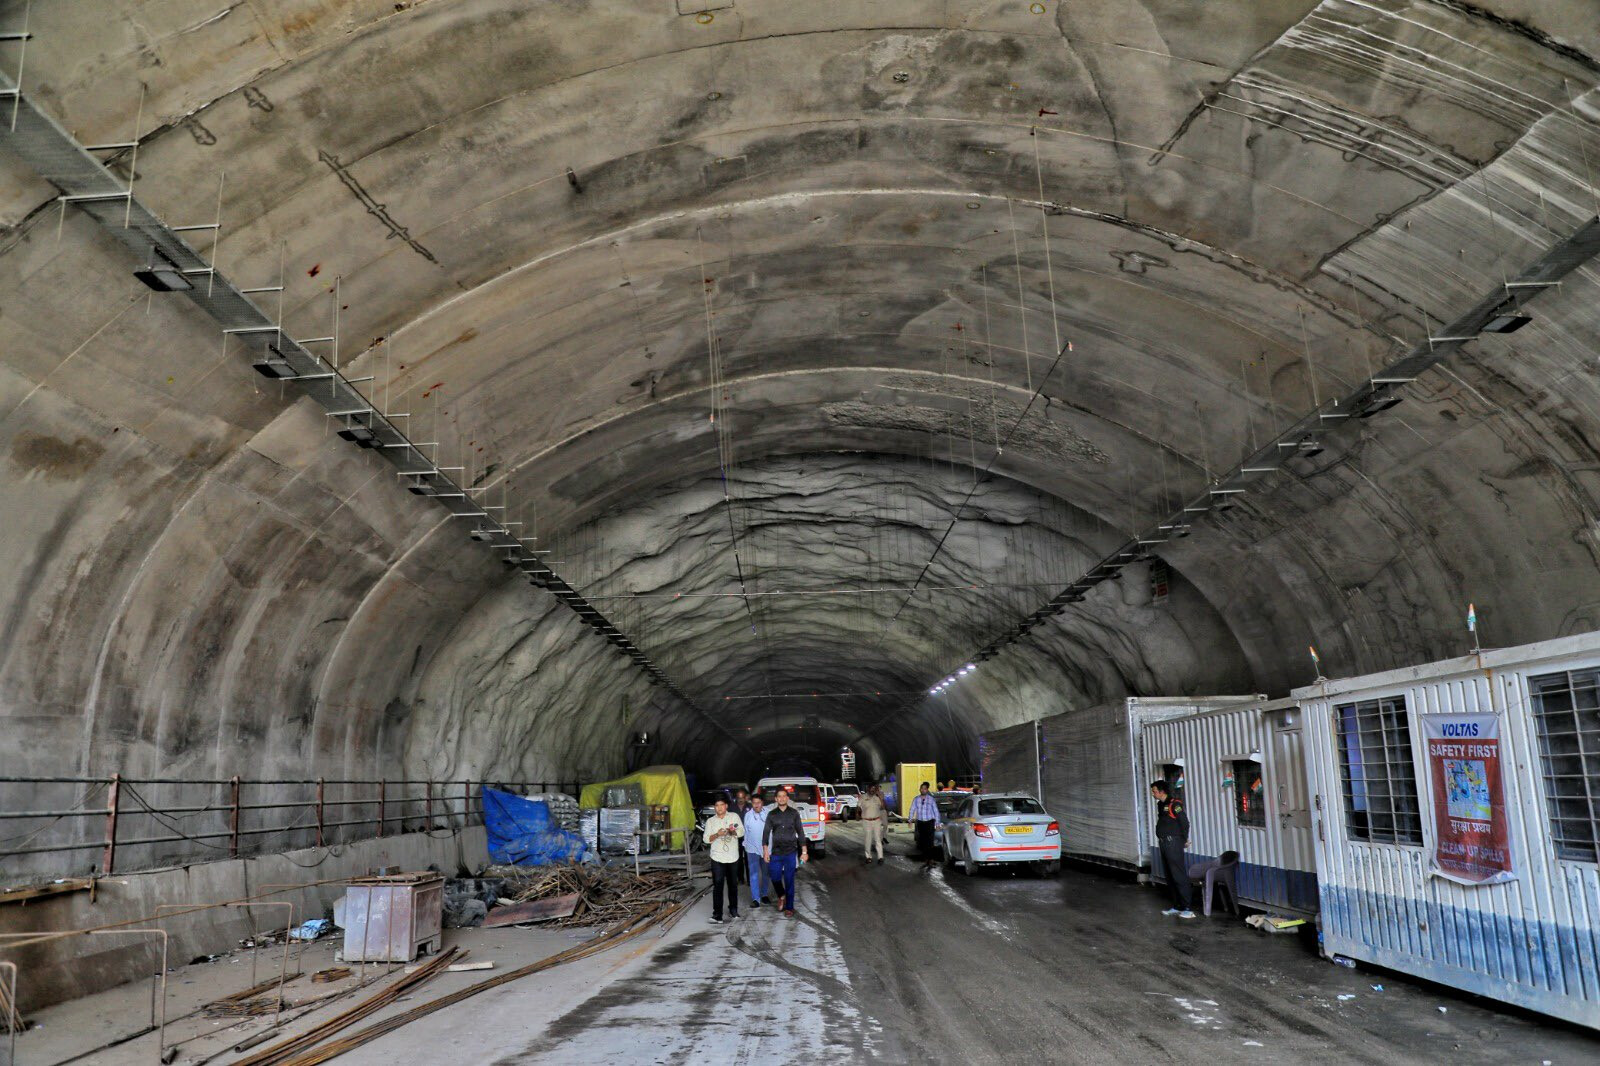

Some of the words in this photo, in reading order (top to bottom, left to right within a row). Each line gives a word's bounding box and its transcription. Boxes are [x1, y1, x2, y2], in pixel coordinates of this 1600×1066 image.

[1442, 723, 1478, 736] VOLTAS
[1430, 744, 1466, 757] SAFETY
[1468, 745, 1497, 758] FIRST
